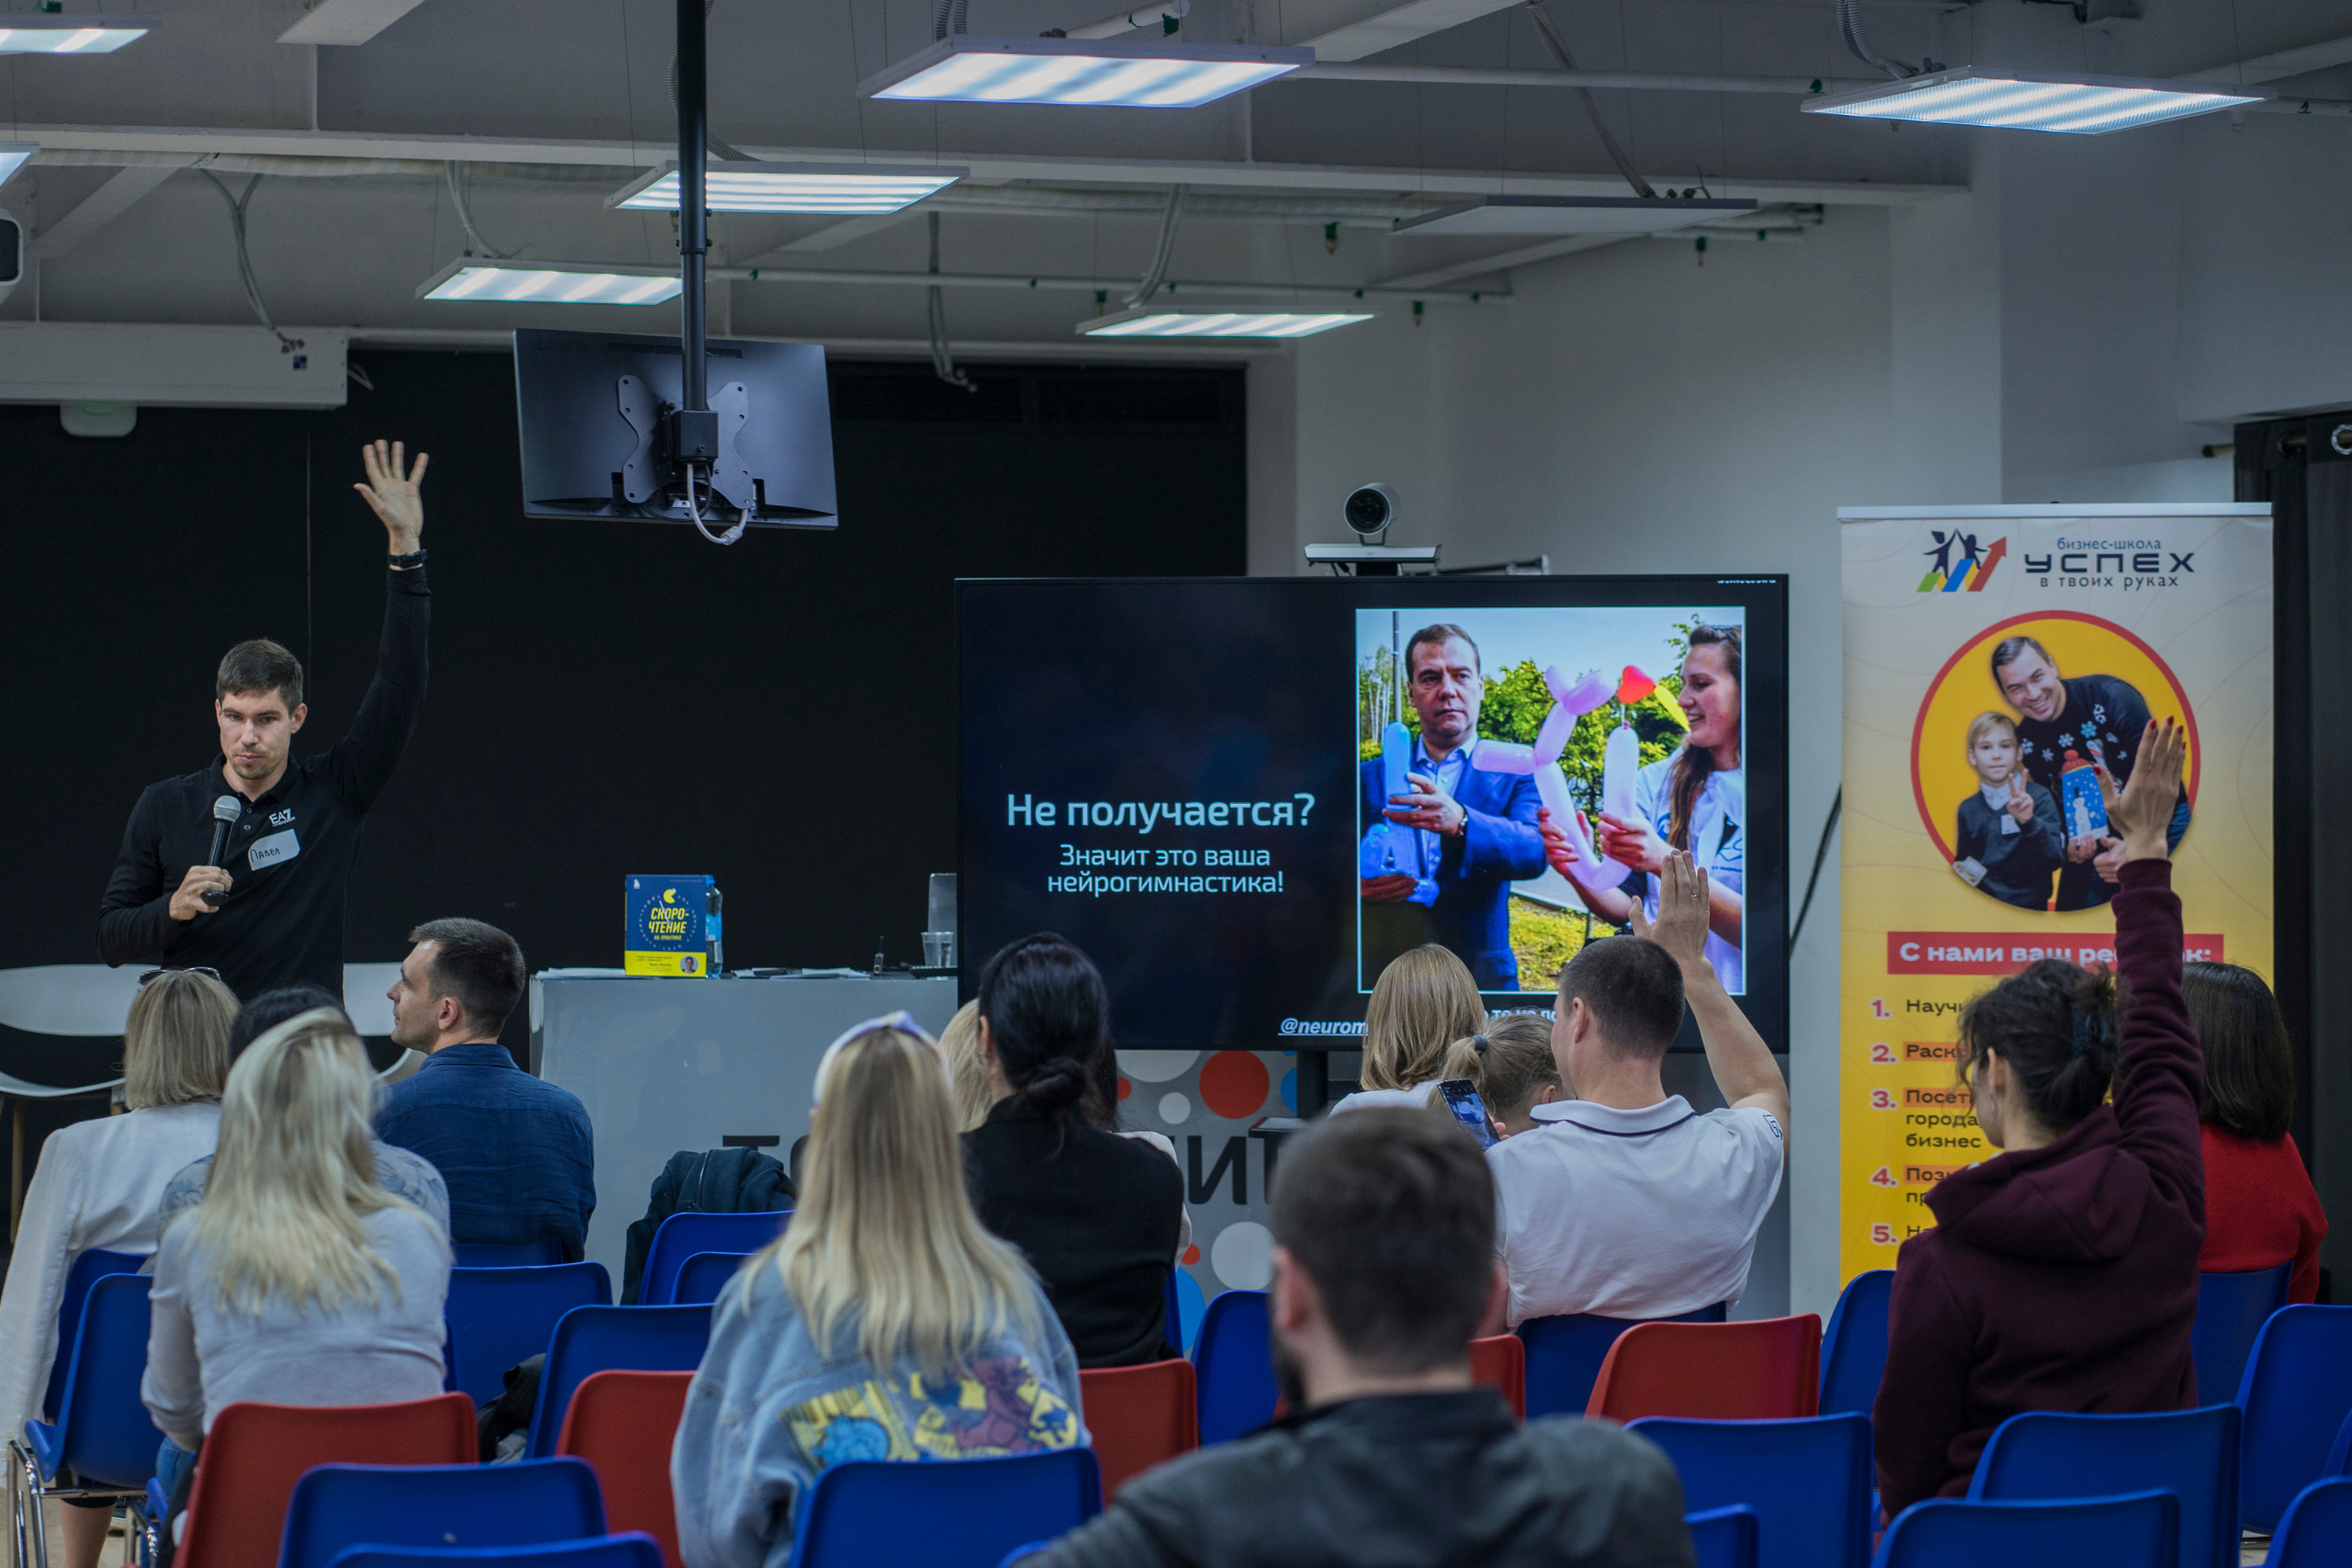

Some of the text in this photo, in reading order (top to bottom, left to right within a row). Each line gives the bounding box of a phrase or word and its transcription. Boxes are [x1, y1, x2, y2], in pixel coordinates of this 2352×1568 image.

[2057, 537, 2162, 550] бизнес-школа
[2024, 553, 2195, 573] УСПЕХ
[2040, 576, 2179, 592] в твоих руках
[269, 808, 291, 824] EA7
[1007, 792, 1317, 835] Не получается?
[1059, 843, 1272, 867] Значит это ваша
[1047, 870, 1284, 898] нейрогимнастика!
[650, 908, 689, 919] СКОРО-
[649, 921, 687, 933] ЧТЕНИЕ
[1899, 942, 1920, 961] С
[1927, 946, 2004, 963] нами
[1871, 999, 1890, 1017] 1.
[1279, 1017, 1368, 1035] @neurom
[1871, 1044, 1958, 1063] 2. Раск
[1871, 1089, 1972, 1109] 3. Посет
[1906, 1133, 1981, 1148] бизнес
[1871, 1168, 1948, 1186] 4. Поз
[1872, 1225, 1896, 1243] 5.
